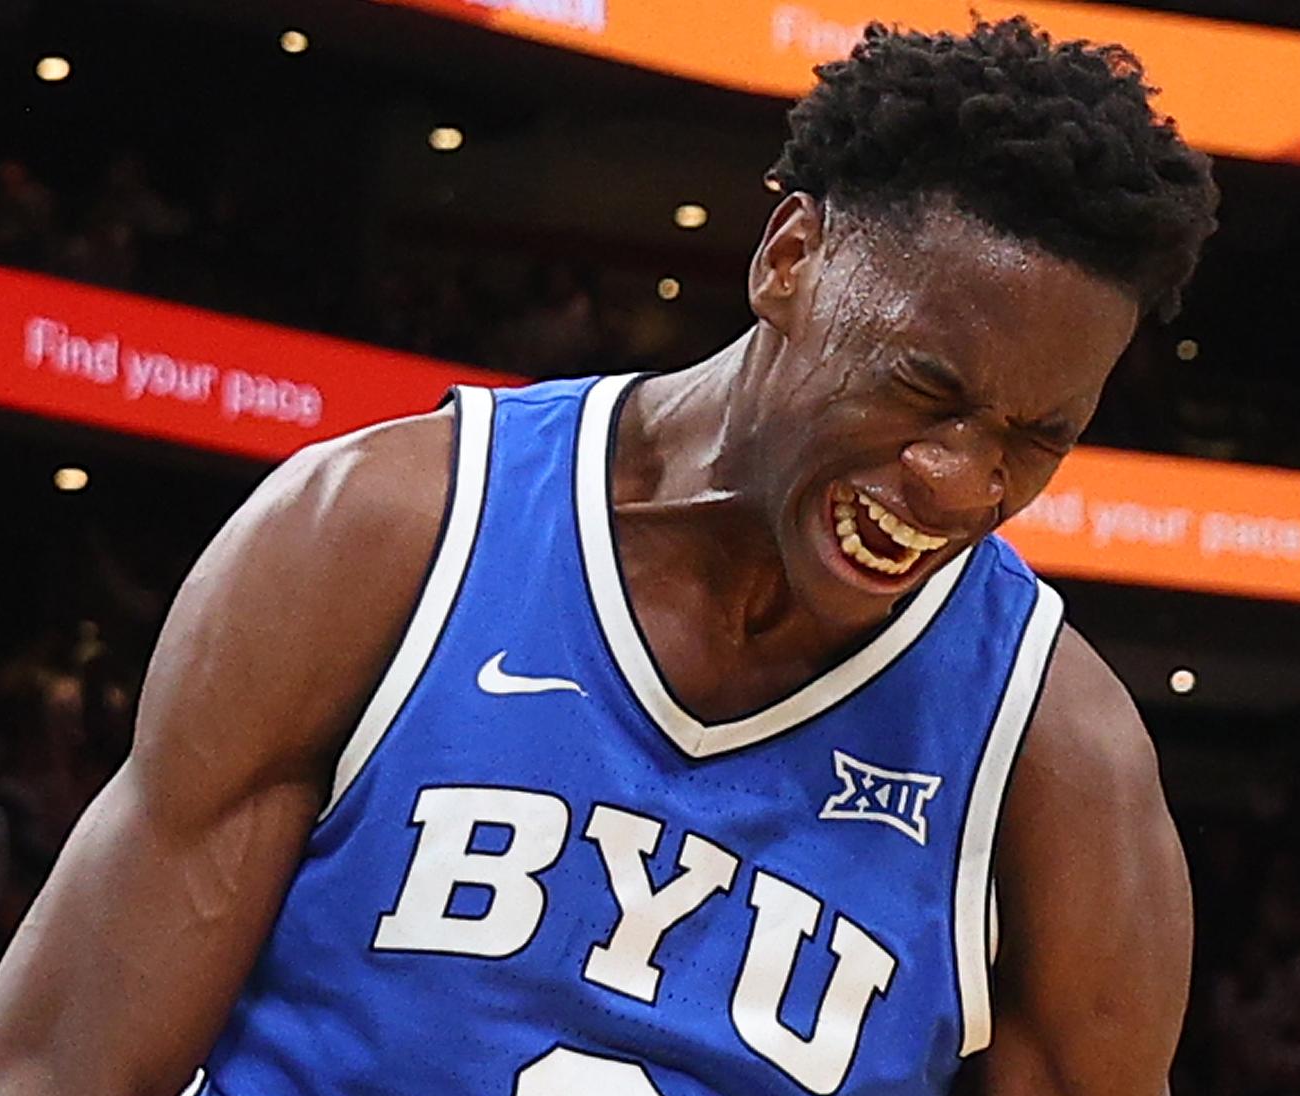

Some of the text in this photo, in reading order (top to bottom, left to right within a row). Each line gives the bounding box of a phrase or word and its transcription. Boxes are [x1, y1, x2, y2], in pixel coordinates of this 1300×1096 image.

[24, 315, 324, 428] Find your pace
[1091, 501, 1192, 550] your
